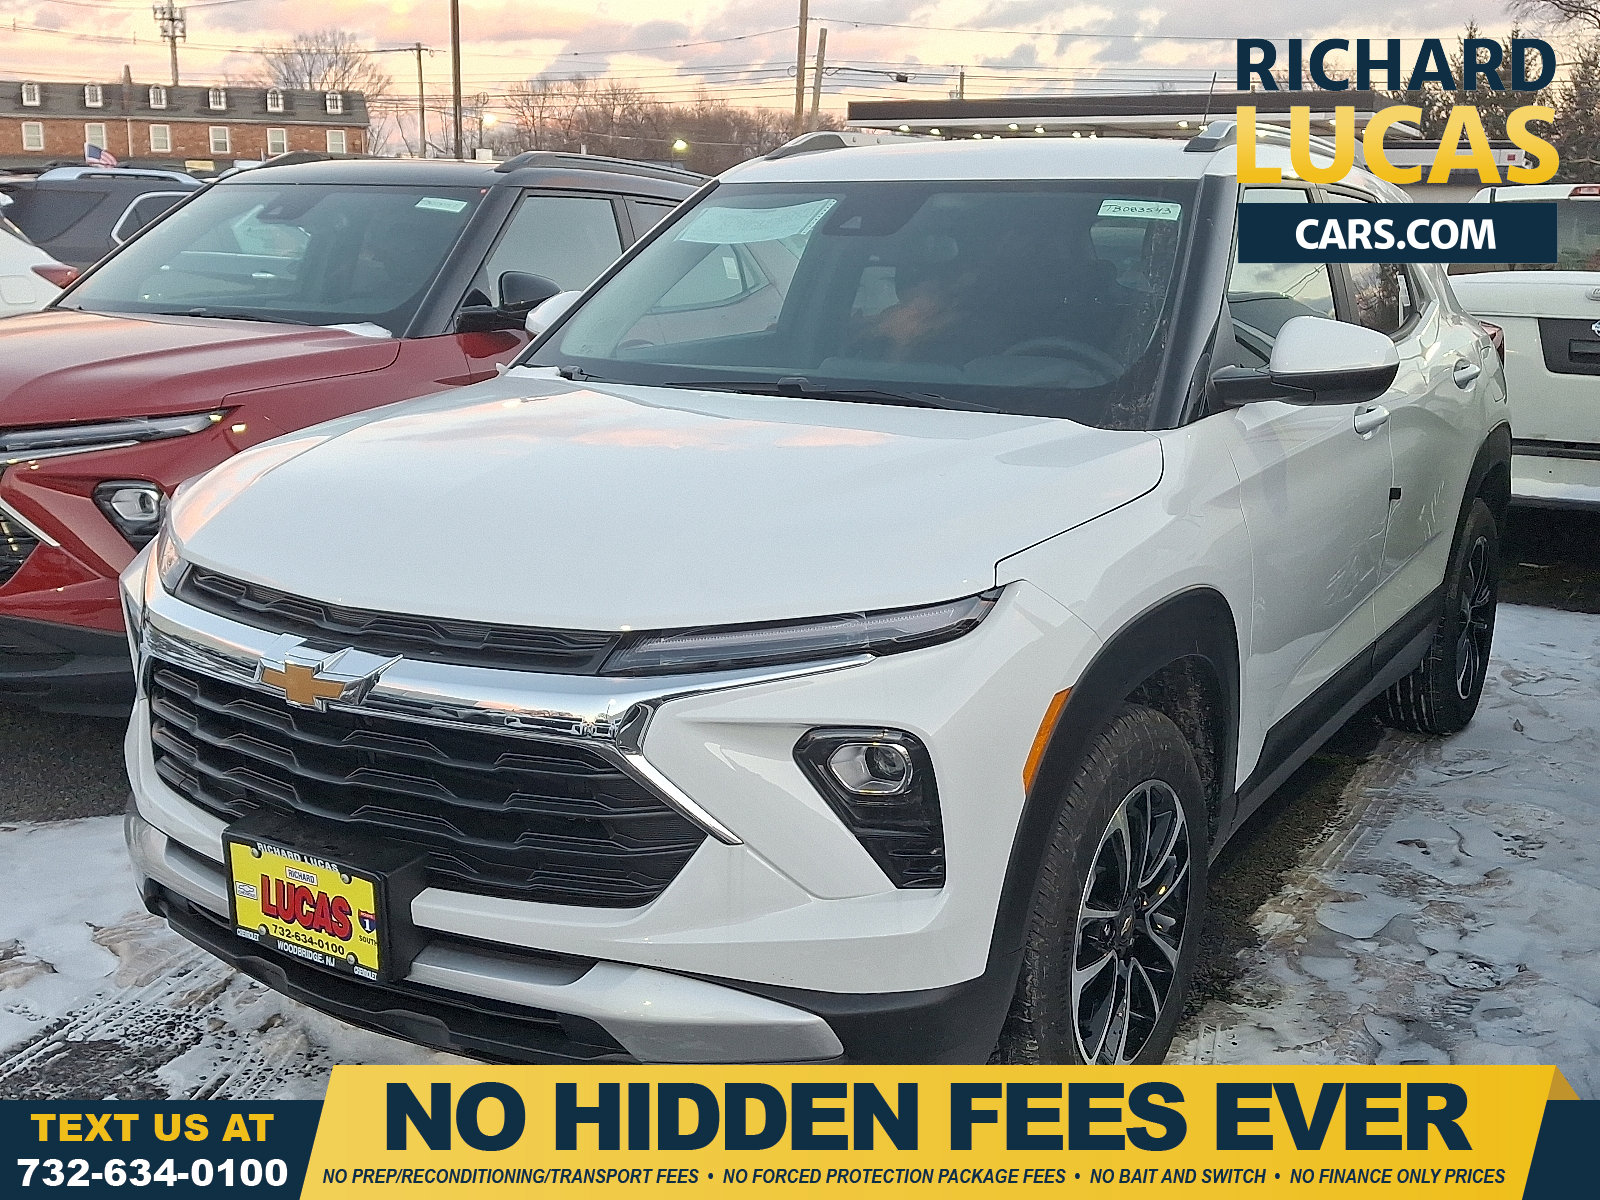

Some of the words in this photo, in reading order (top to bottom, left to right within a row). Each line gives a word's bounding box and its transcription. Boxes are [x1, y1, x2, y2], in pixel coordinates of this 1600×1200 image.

[256, 841, 302, 862] RICHARD
[303, 855, 339, 873] LUCAS
[287, 868, 316, 885] RICHARD
[260, 874, 353, 942] LUCAS
[271, 923, 345, 956] 732-634-0100
[325, 955, 335, 968] NJ
